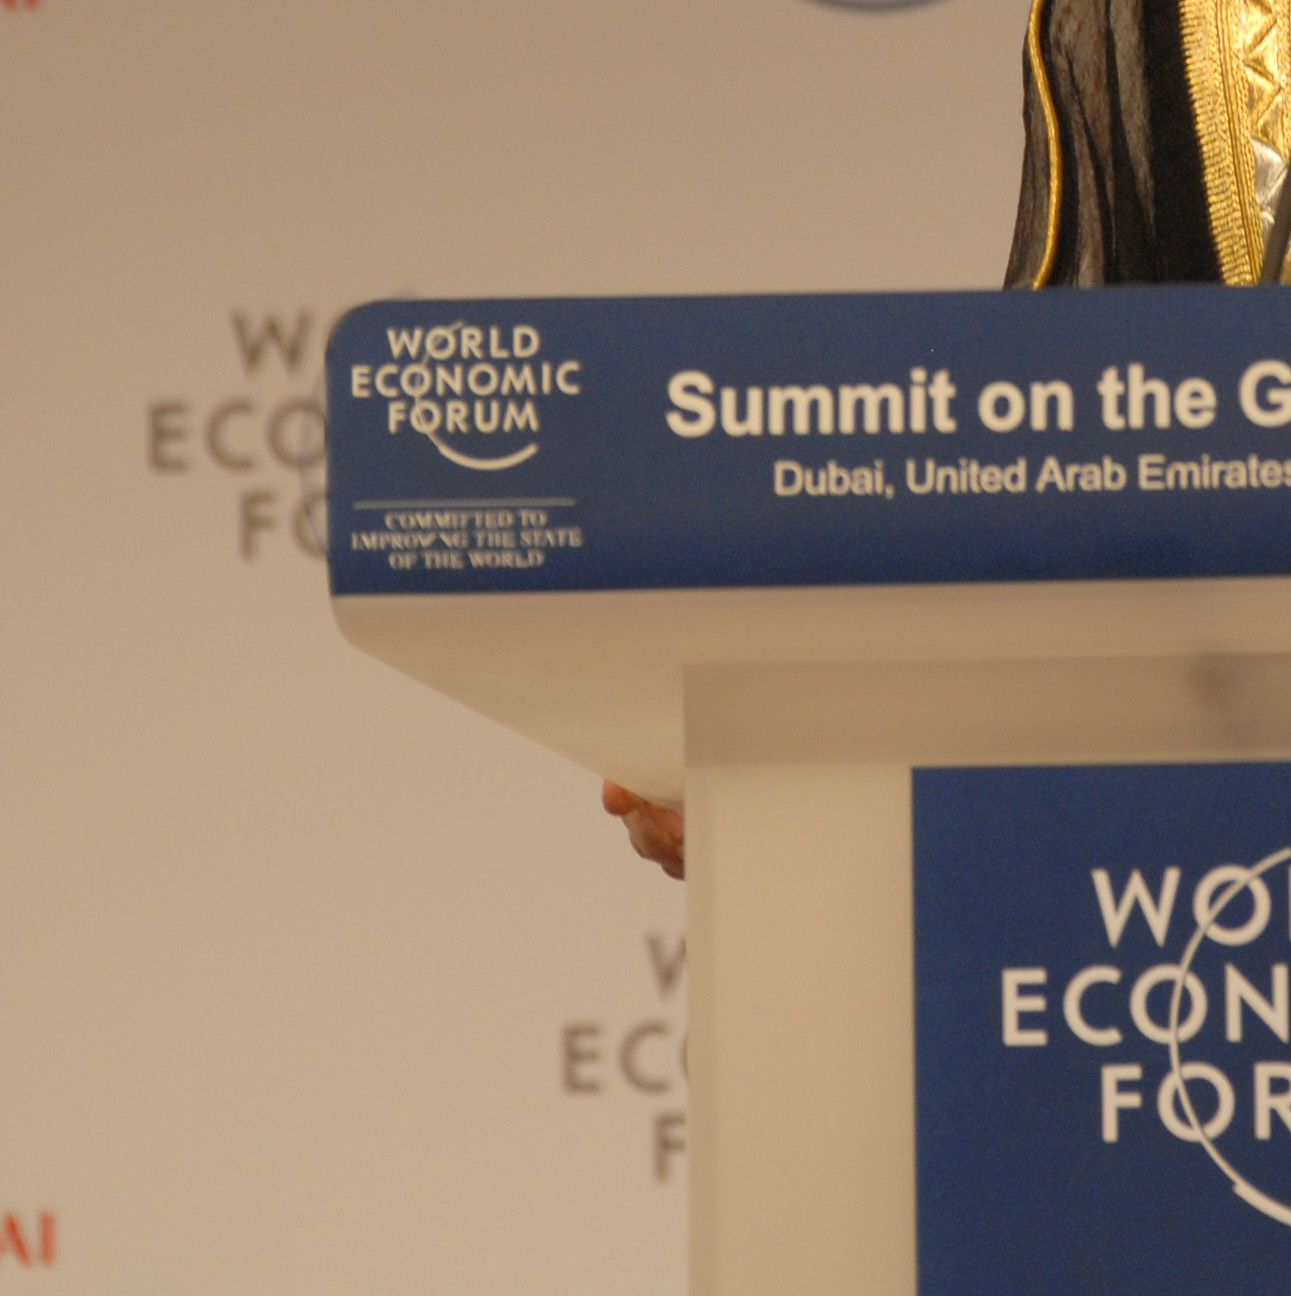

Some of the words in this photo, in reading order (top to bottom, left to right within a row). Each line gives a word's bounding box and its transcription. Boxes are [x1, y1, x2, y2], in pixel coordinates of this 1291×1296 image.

[387, 325, 541, 360] WORLD
[351, 361, 581, 397] ECONOMIC
[387, 399, 540, 434] FORUM
[666, 368, 958, 438] Summit
[977, 380, 1074, 432] on
[1097, 363, 1217, 430] the
[774, 459, 895, 499] Dubai,
[906, 457, 1027, 494] United
[1036, 455, 1127, 494] Arab
[519, 508, 547, 527] TO
[474, 529, 516, 548] THE
[520, 526, 584, 548] STATE
[388, 551, 418, 570] OF
[422, 550, 465, 570] THE
[467, 549, 545, 570] WORLD
